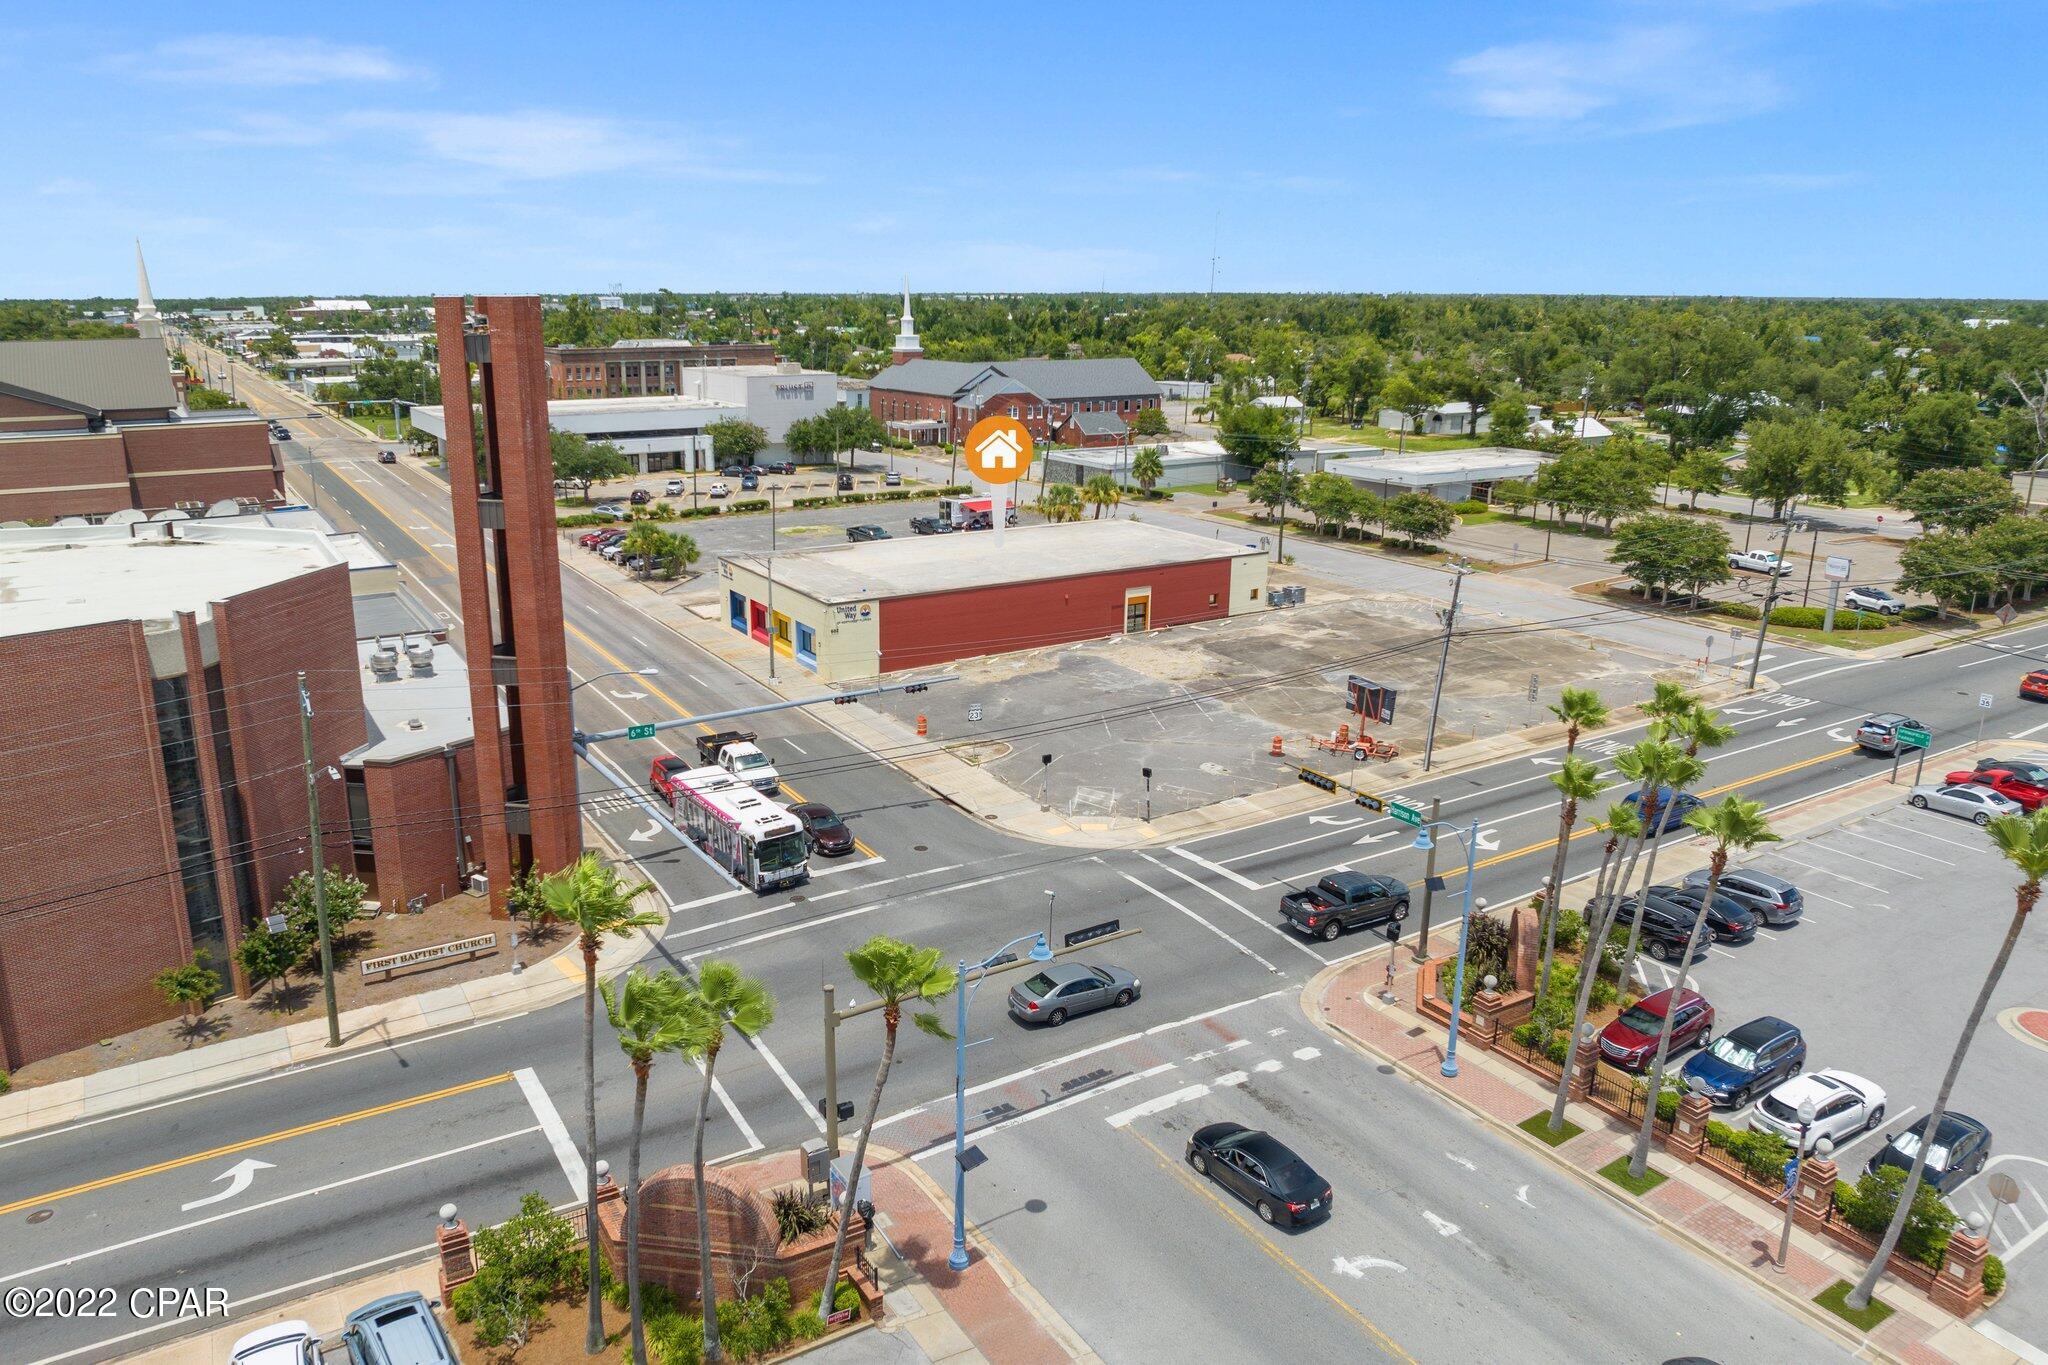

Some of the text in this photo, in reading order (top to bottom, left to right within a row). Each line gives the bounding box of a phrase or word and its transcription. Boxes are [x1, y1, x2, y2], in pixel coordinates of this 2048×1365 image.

[836, 605, 857, 614] United
[844, 612, 857, 620] Way
[1980, 699, 1990, 707] 35
[643, 726, 653, 736] St
[1391, 805, 1421, 824] Harrison Ave
[366, 936, 493, 970] FIRST BAPTIST CHURCH
